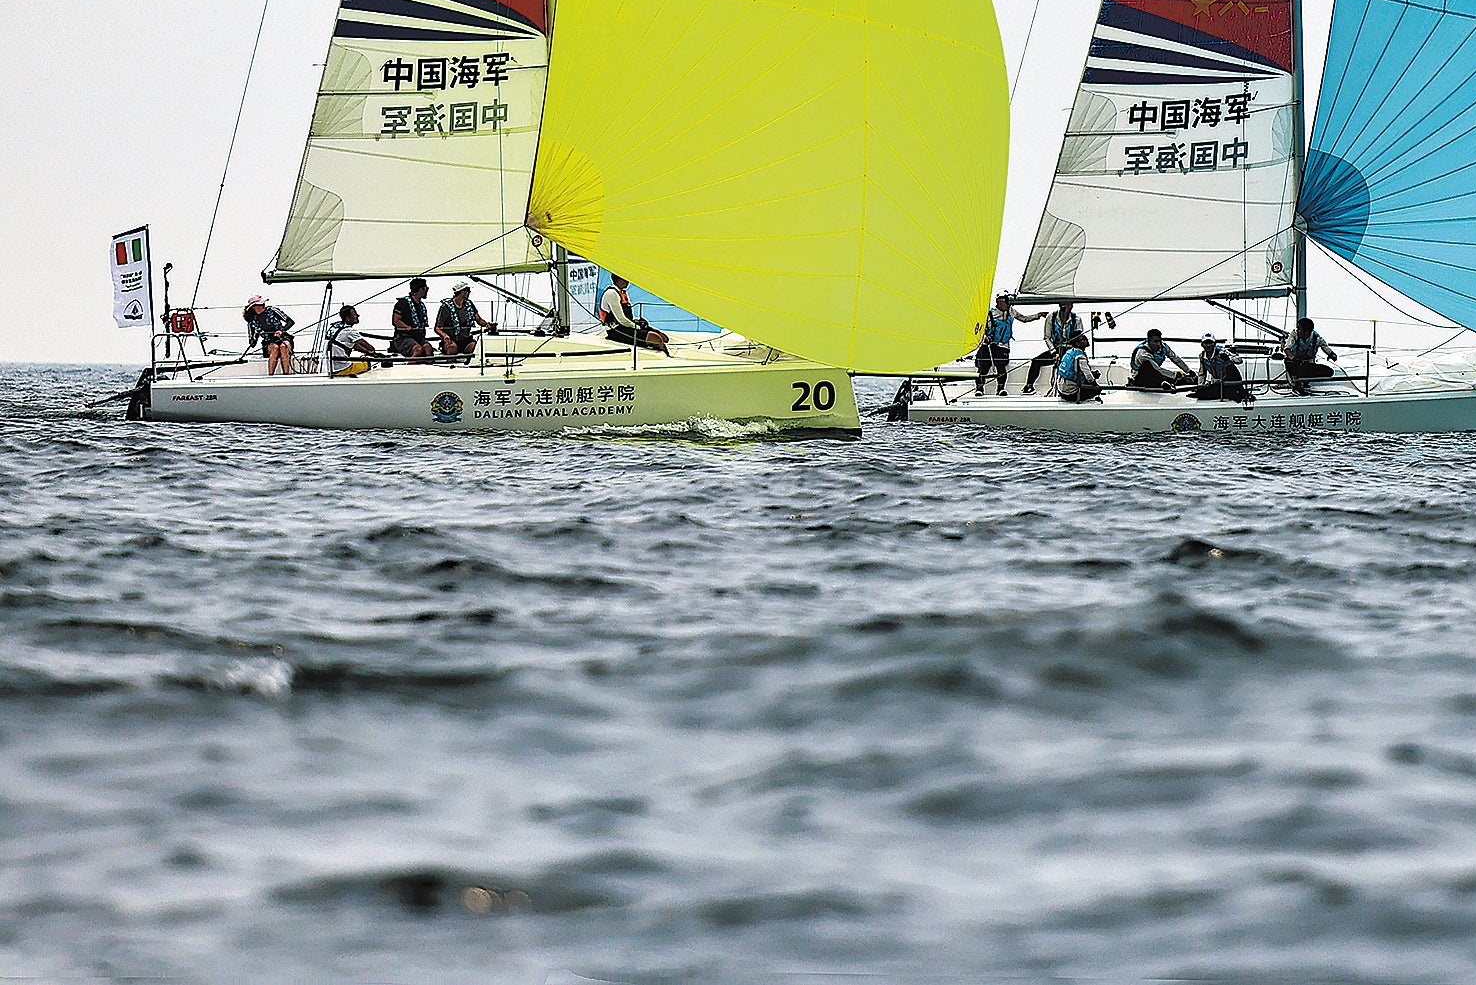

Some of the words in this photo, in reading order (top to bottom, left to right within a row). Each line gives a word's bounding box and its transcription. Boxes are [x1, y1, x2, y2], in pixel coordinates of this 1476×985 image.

[382, 52, 510, 91] 中国海军
[1128, 92, 1251, 132] 中国海军
[473, 384, 635, 407] 海军大连舰艇学院
[790, 380, 836, 412] 20
[474, 409, 523, 419] DALIAN
[526, 407, 568, 417] NAVAL
[571, 405, 634, 416] ACADEMY
[1213, 410, 1362, 430] 海军大连舰艇学院
